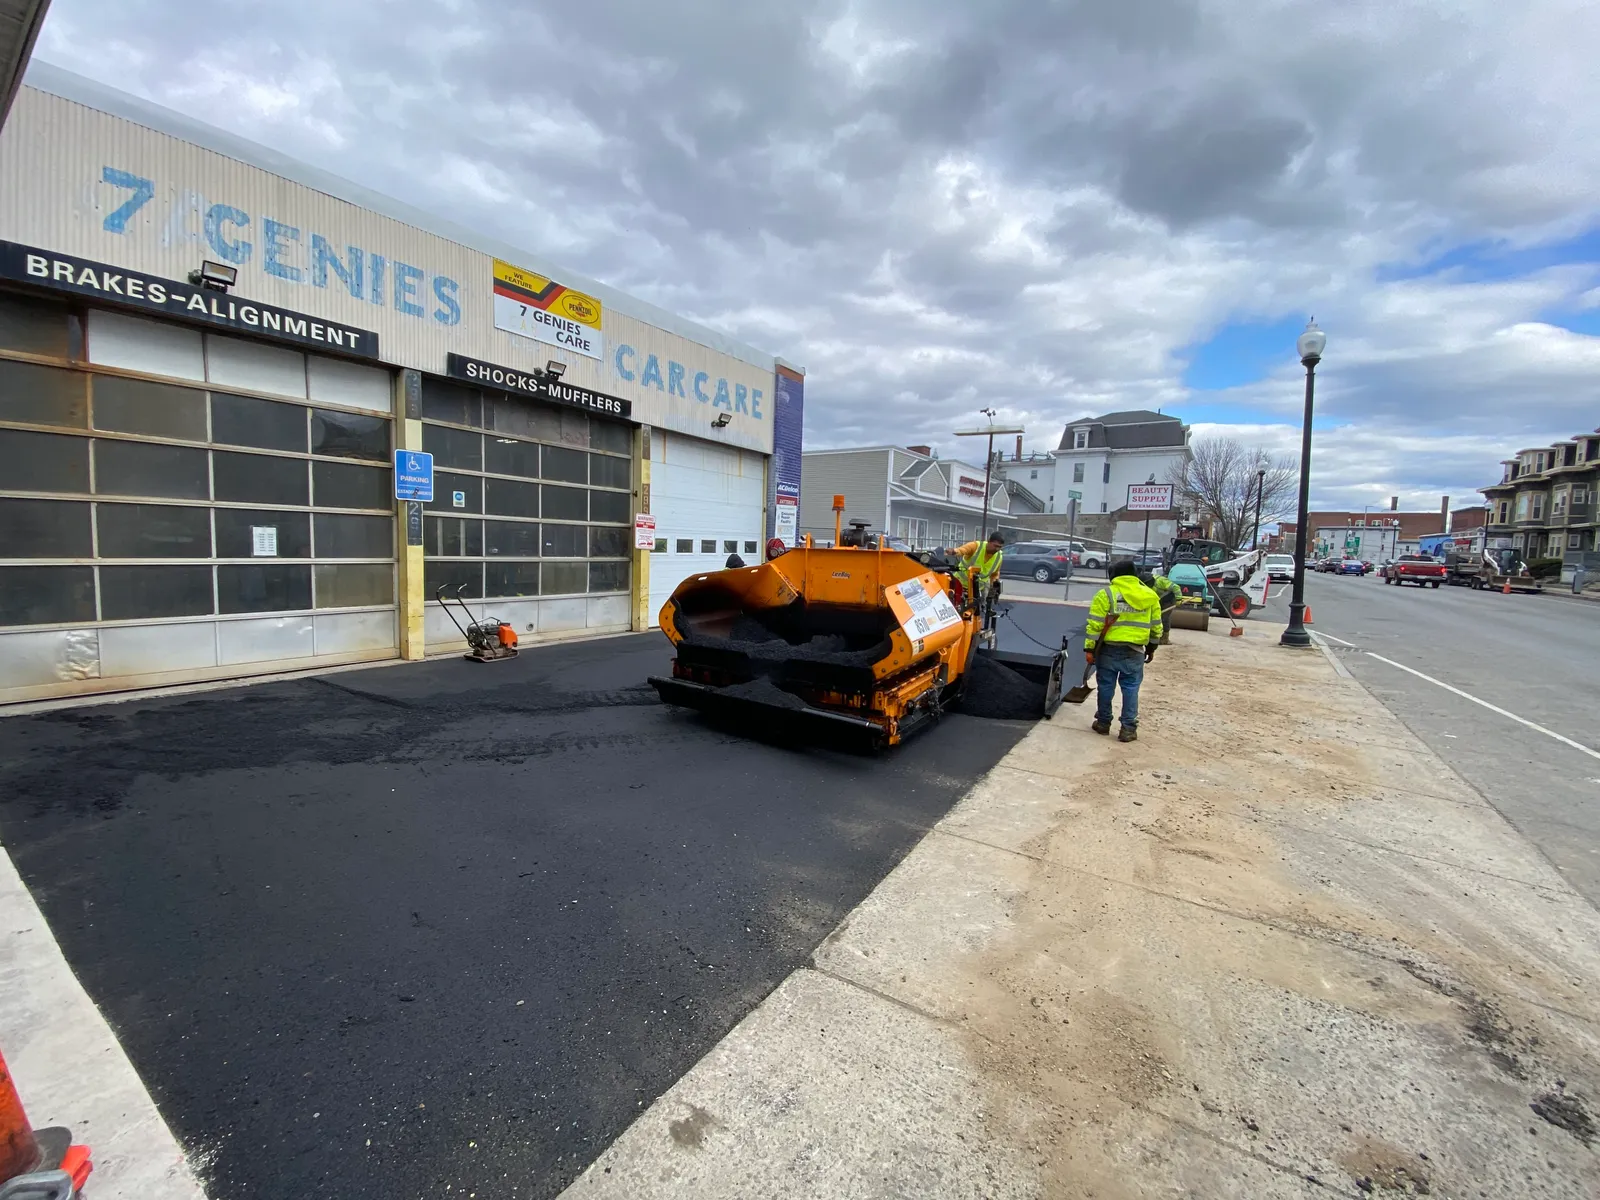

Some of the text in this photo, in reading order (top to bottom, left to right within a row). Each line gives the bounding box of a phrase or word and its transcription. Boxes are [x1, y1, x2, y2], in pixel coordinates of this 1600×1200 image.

[102, 165, 462, 327] 7 GENIES
[504, 275, 532, 290] FEATURE
[513, 272, 523, 280] WE
[26, 253, 361, 350] BRAKES-ALIGNMENT
[568, 303, 592, 316] PENNZOIL
[520, 305, 527, 317] 7
[533, 310, 581, 336] GENIES
[556, 331, 590, 351] CARE
[466, 362, 621, 413] SHOCKS-MUFFLERS
[615, 343, 763, 420] CAR CARE
[400, 475, 429, 484] PARKING
[777, 484, 798, 493] ACDelco
[1132, 495, 1167, 503] SUPPLY
